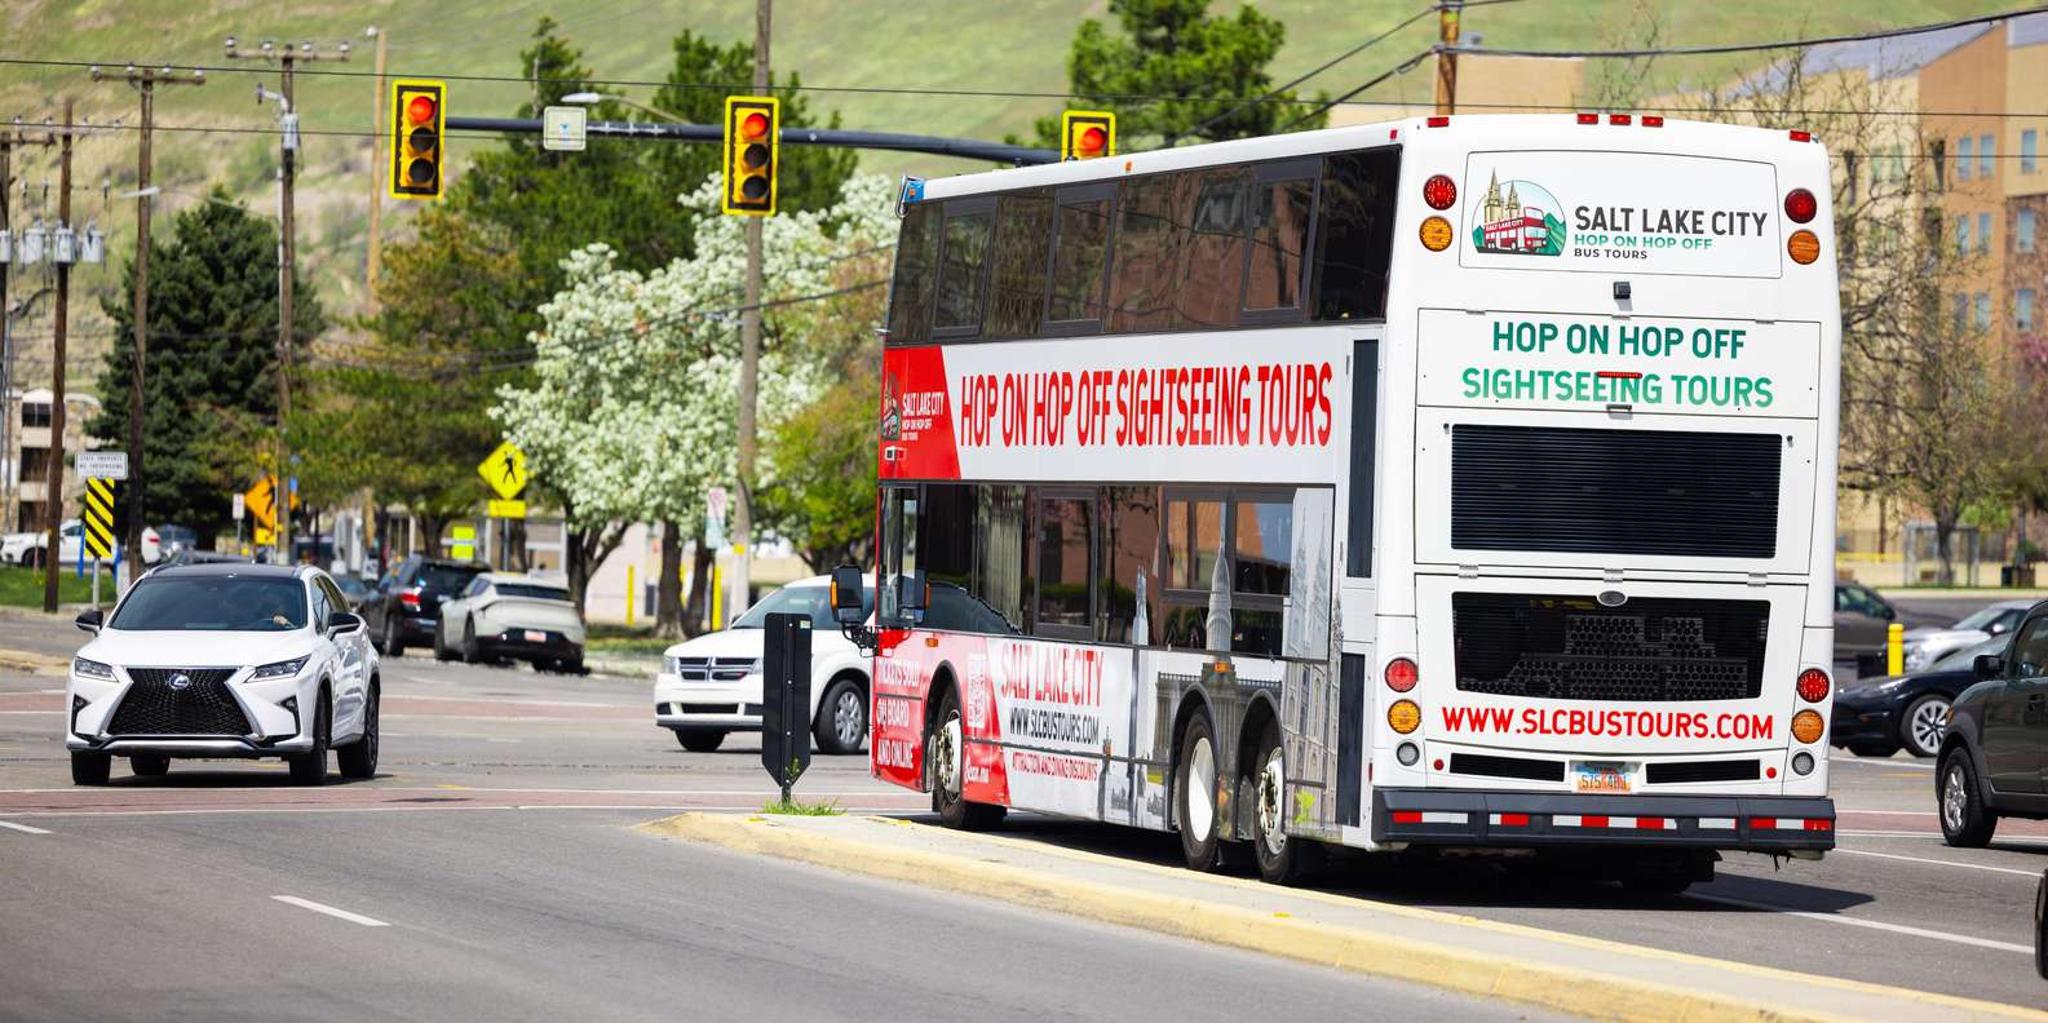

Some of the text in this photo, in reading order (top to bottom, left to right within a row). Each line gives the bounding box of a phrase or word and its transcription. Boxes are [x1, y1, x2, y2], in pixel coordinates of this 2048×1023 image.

[1574, 206, 1768, 237] SALT LAKE CITY
[1574, 234, 1713, 250] HOP ON HOP OFF
[1574, 248, 1648, 260] BUS TOURS
[1493, 321, 1746, 359] HOP ON HOP OFF
[903, 391, 945, 416] SALT LAKE CITY
[1462, 367, 1774, 408] SIGHTSEEING TOURS
[961, 362, 1333, 447] HOP ON HOP OFF SIGHTSEEING TOURS
[1001, 642, 1104, 706] SALT LAKE CITY
[888, 699, 909, 728] BOARD
[1010, 707, 1099, 745] WWW.SLCBUSTOURS.COM
[1442, 707, 1774, 739] WWW.SLCBUSTOURS.COM
[878, 737, 914, 769] AND ONLINE
